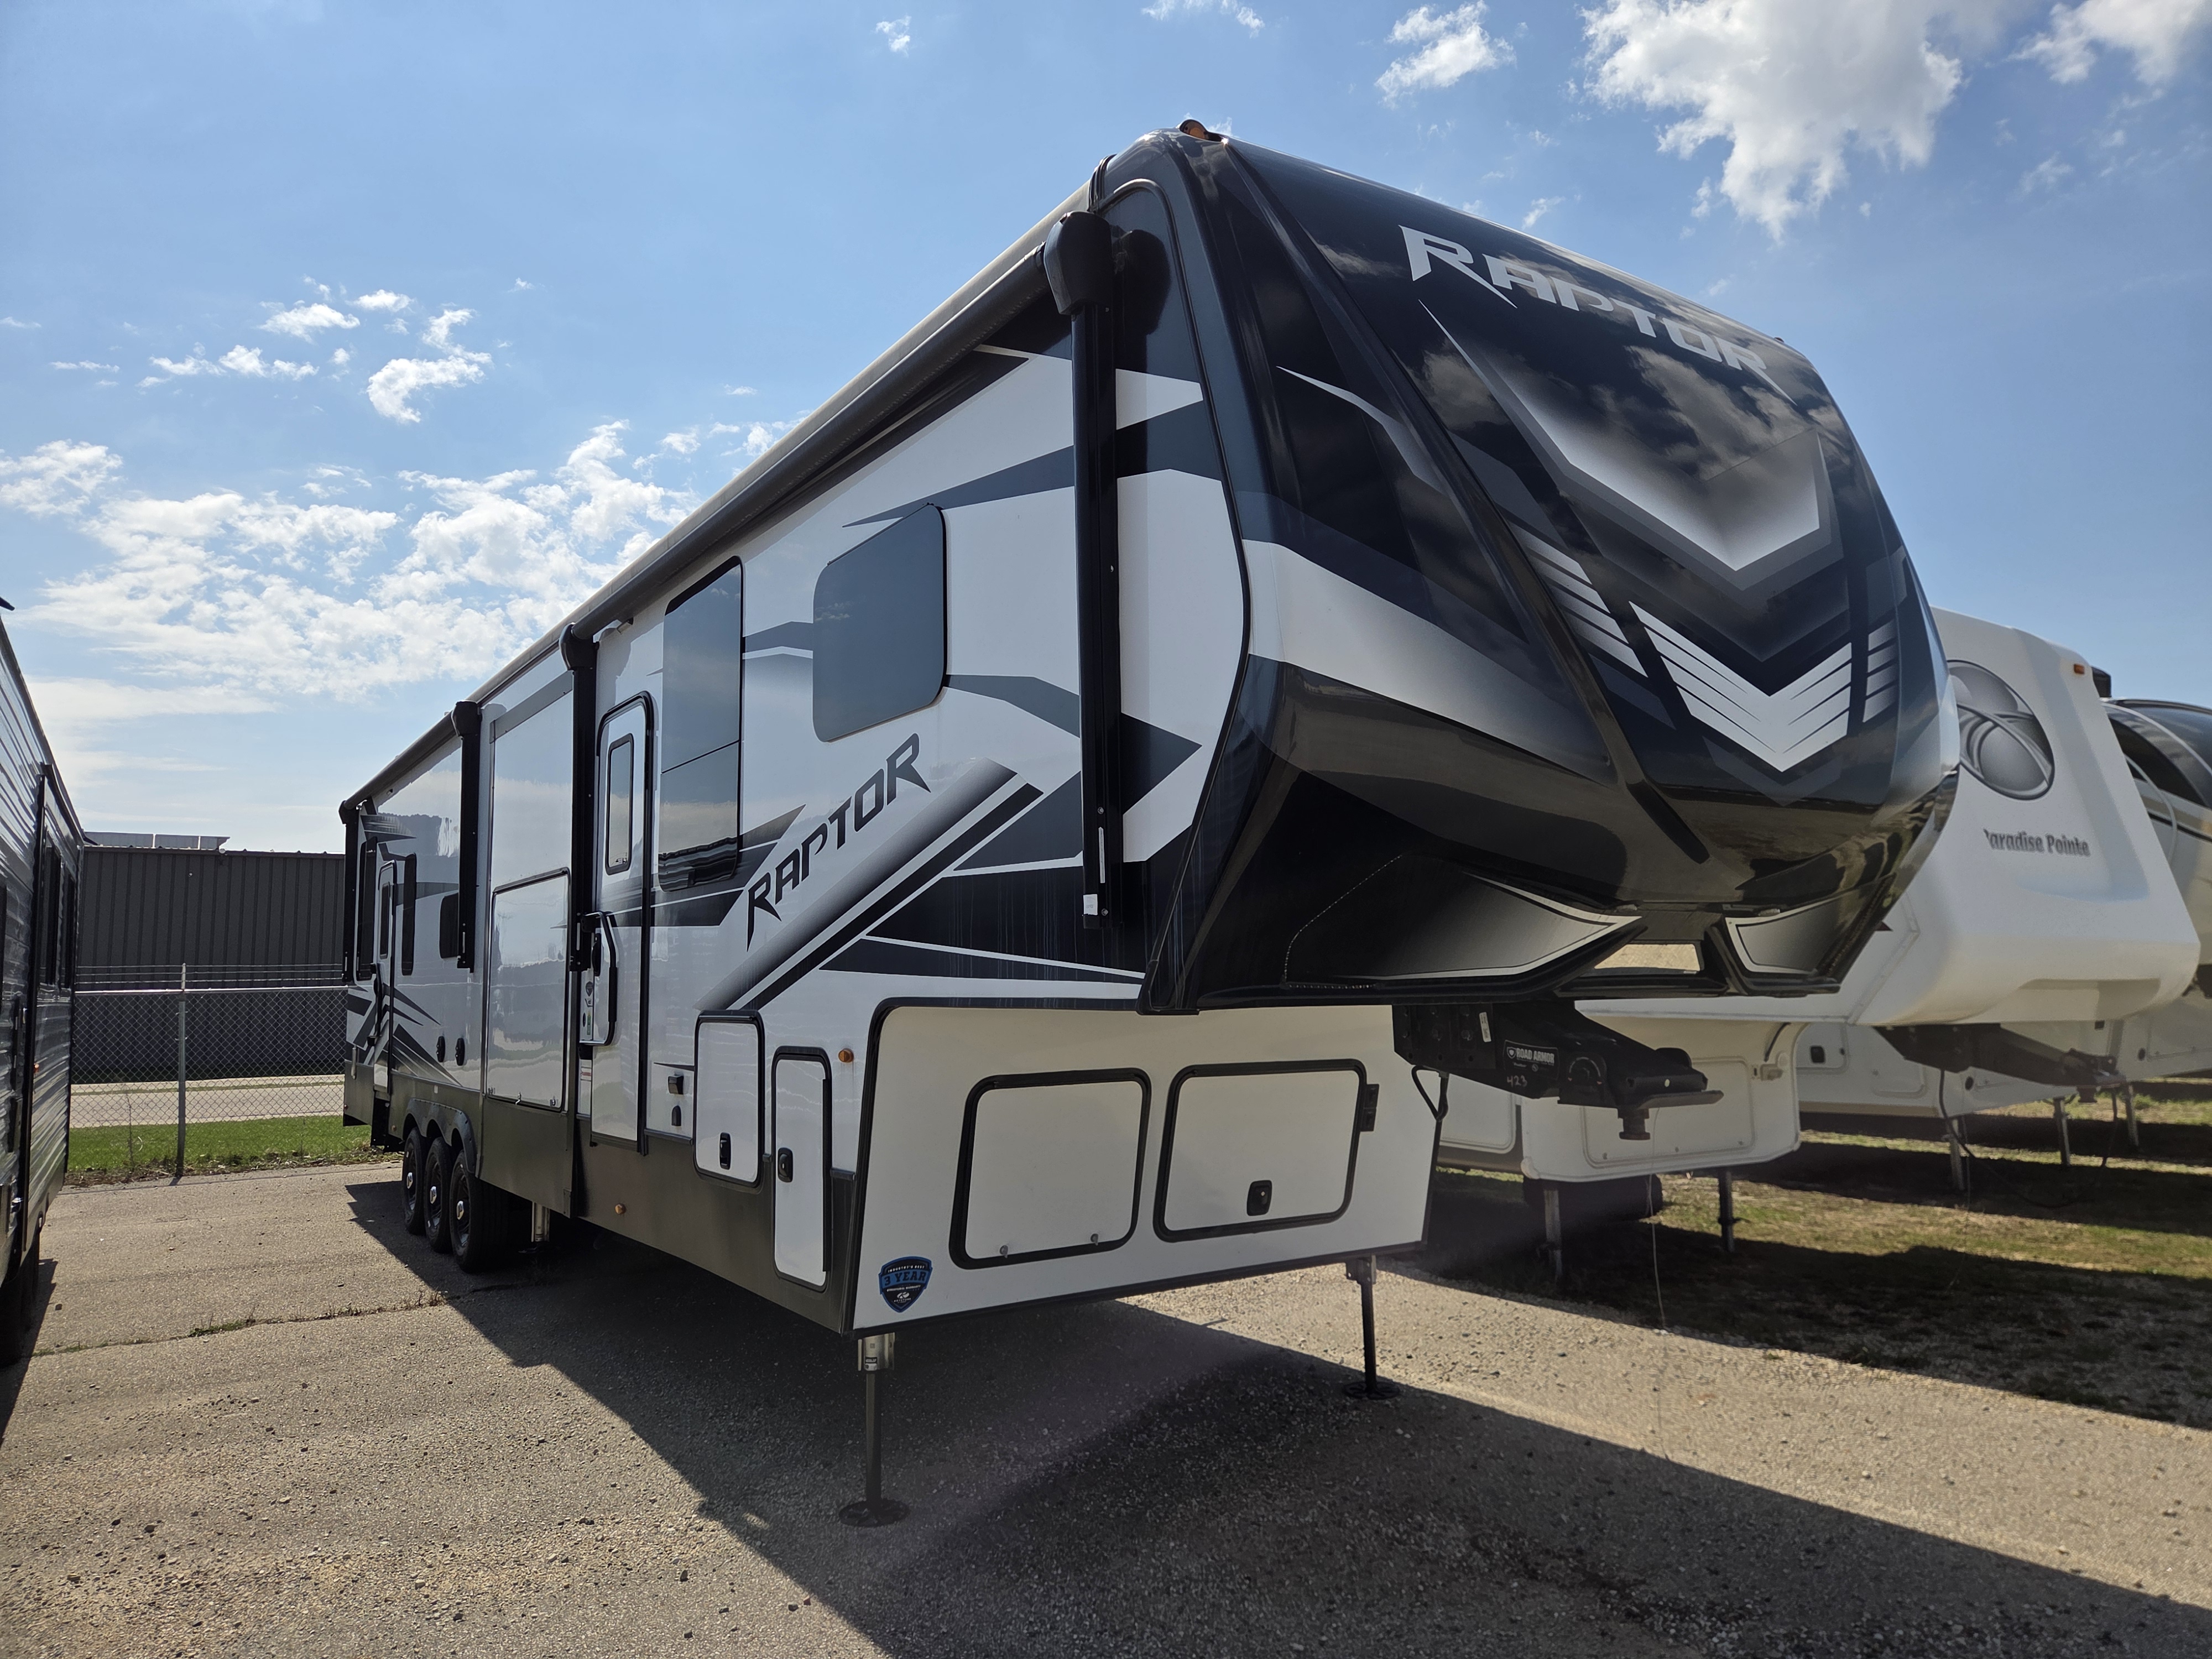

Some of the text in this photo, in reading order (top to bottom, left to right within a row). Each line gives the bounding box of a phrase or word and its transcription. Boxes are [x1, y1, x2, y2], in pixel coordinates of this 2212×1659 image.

[1399, 225, 1797, 406] RAPTOR
[747, 732, 931, 953] RAPTOR
[2046, 833, 2091, 857] Pointe
[1516, 1047, 1554, 1064] ROAD ARMOR
[1506, 1075, 1527, 1088] 423
[884, 1271, 926, 1287] 3 YEAR
